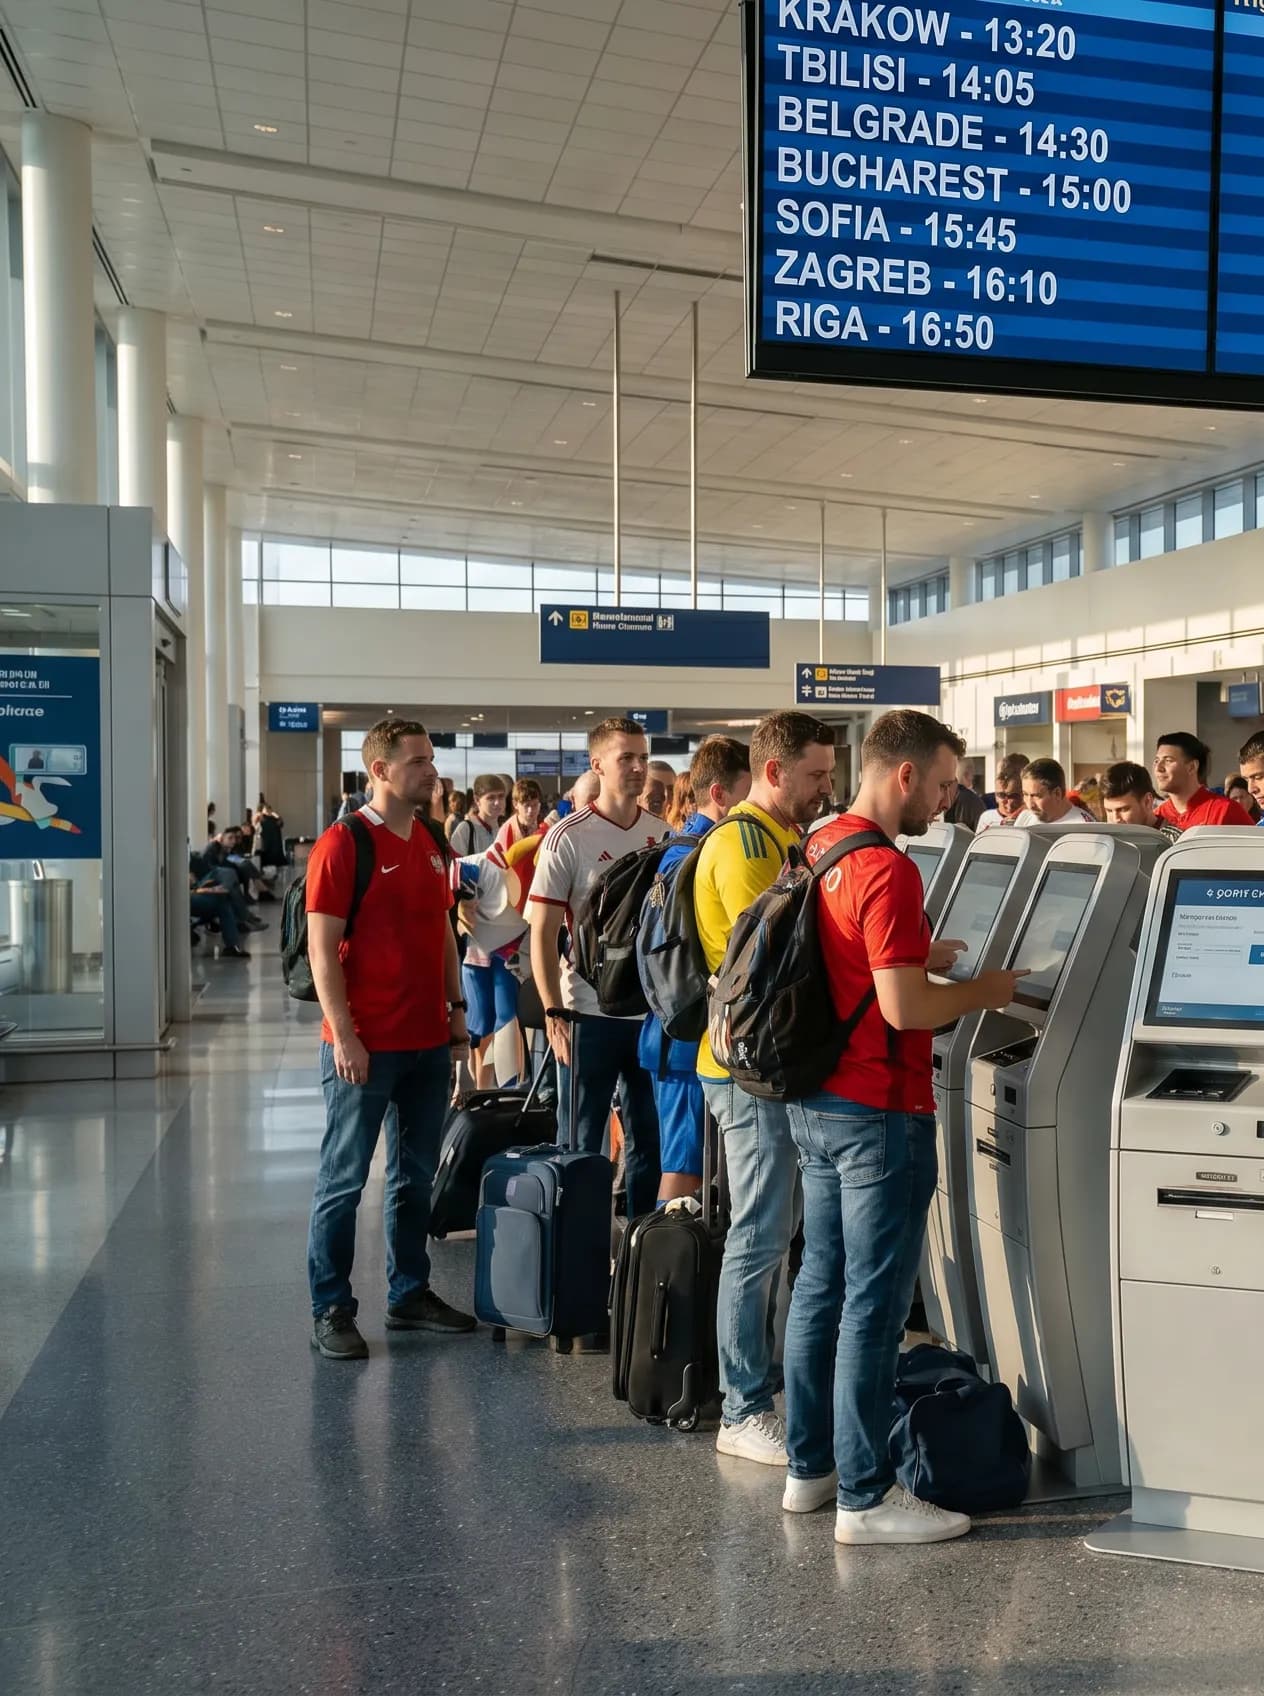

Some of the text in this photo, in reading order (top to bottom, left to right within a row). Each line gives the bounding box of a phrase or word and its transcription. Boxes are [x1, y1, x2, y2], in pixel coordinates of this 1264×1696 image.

[779, 0, 950, 46] KRAKOW
[985, 17, 1076, 61] 13:20
[777, 43, 905, 93] TBILISI
[942, 63, 1034, 106] 14:05
[778, 95, 983, 151] BELGRADE
[1019, 121, 1109, 163] 14:30
[778, 146, 1008, 202] BUCHAREST
[1042, 173, 1131, 214] 15:00
[776, 198, 891, 243] SOFIA
[925, 211, 1016, 253] 15:45
[774, 248, 931, 296] ZAGREB
[967, 265, 1057, 305] 16:10
[776, 300, 869, 341] RIGA
[902, 310, 994, 350] 16:50
